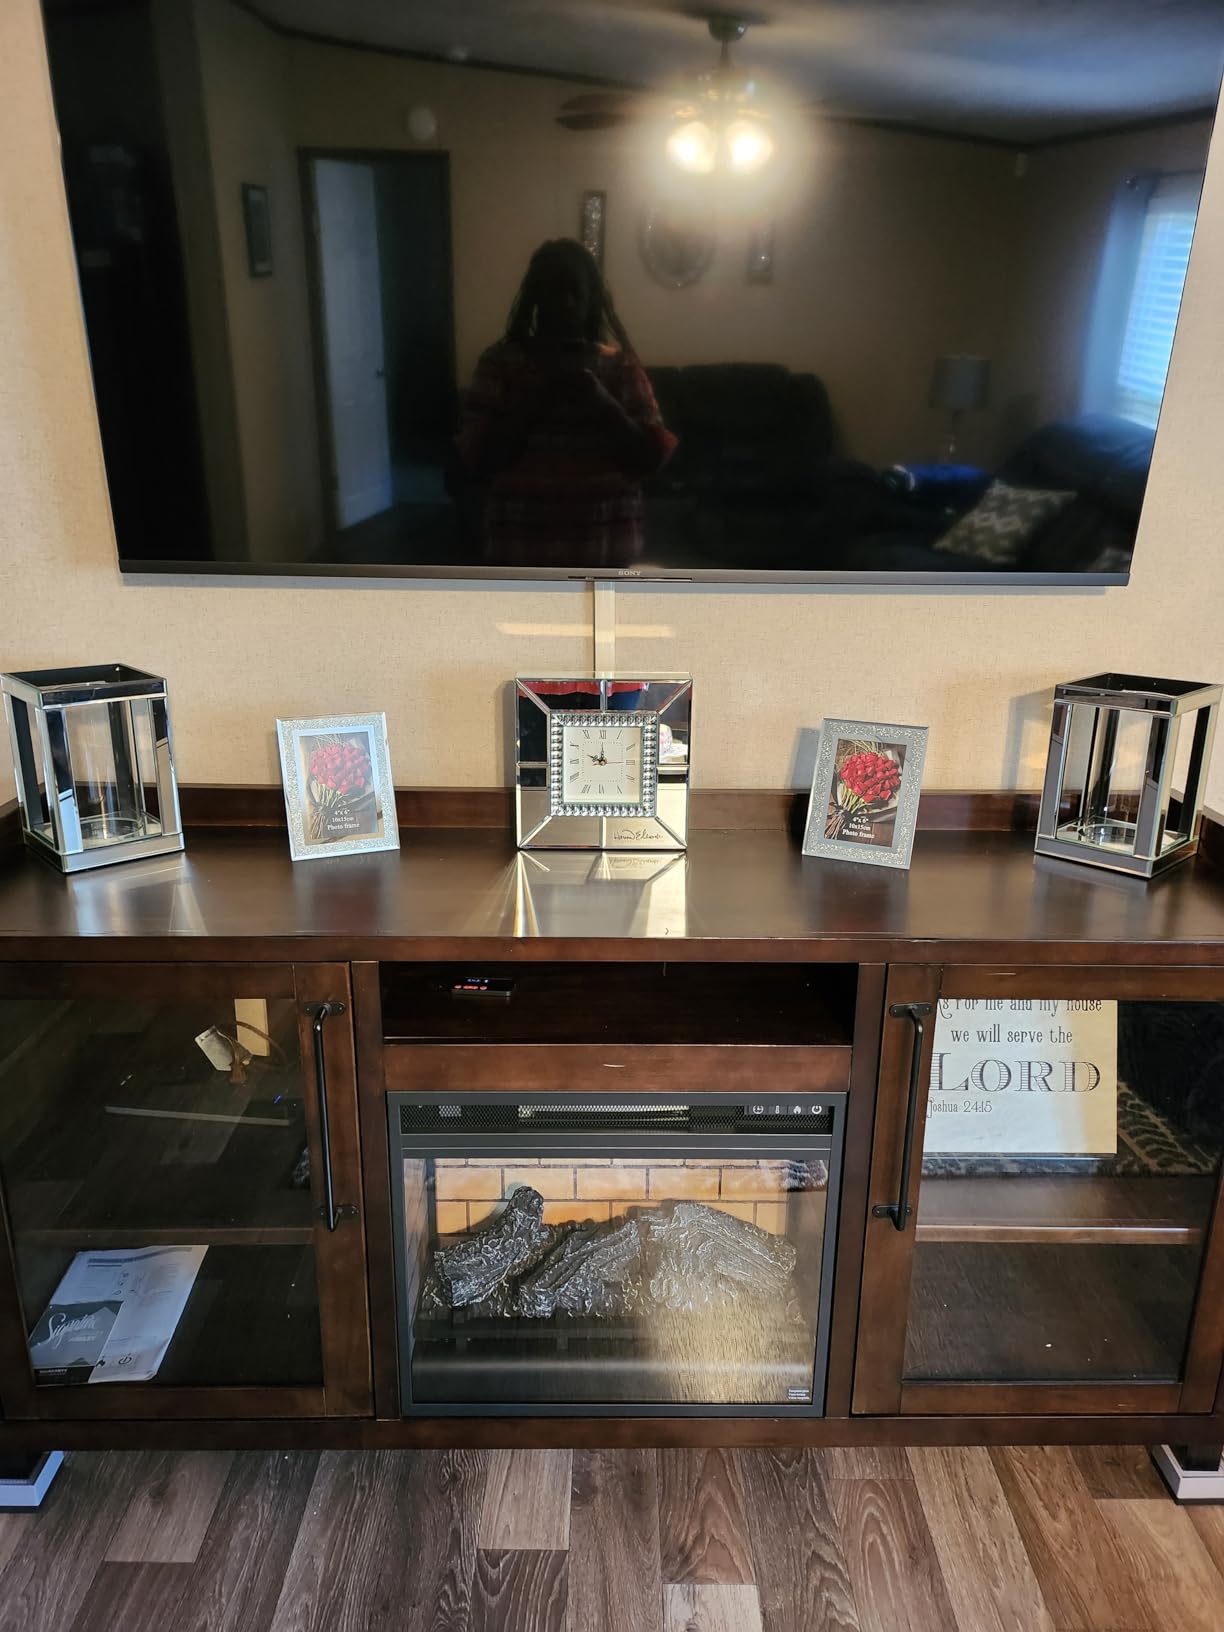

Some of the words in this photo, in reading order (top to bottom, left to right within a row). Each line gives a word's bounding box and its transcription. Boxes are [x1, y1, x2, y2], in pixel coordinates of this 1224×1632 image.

[842, 829, 858, 837] Photo
[859, 831, 875, 839] frame
[985, 999, 1003, 1011] me
[1010, 1000, 1032, 1011] and
[1039, 1000, 1058, 1017] my
[951, 1030, 969, 1043] we
[976, 1024, 1001, 1043] will
[1007, 1030, 1043, 1044] serve
[1050, 1026, 1073, 1044] the
[929, 1052, 1101, 1092] LORD
[927, 1096, 959, 1118] Joshua
[963, 1100, 993, 1113] 24:15
